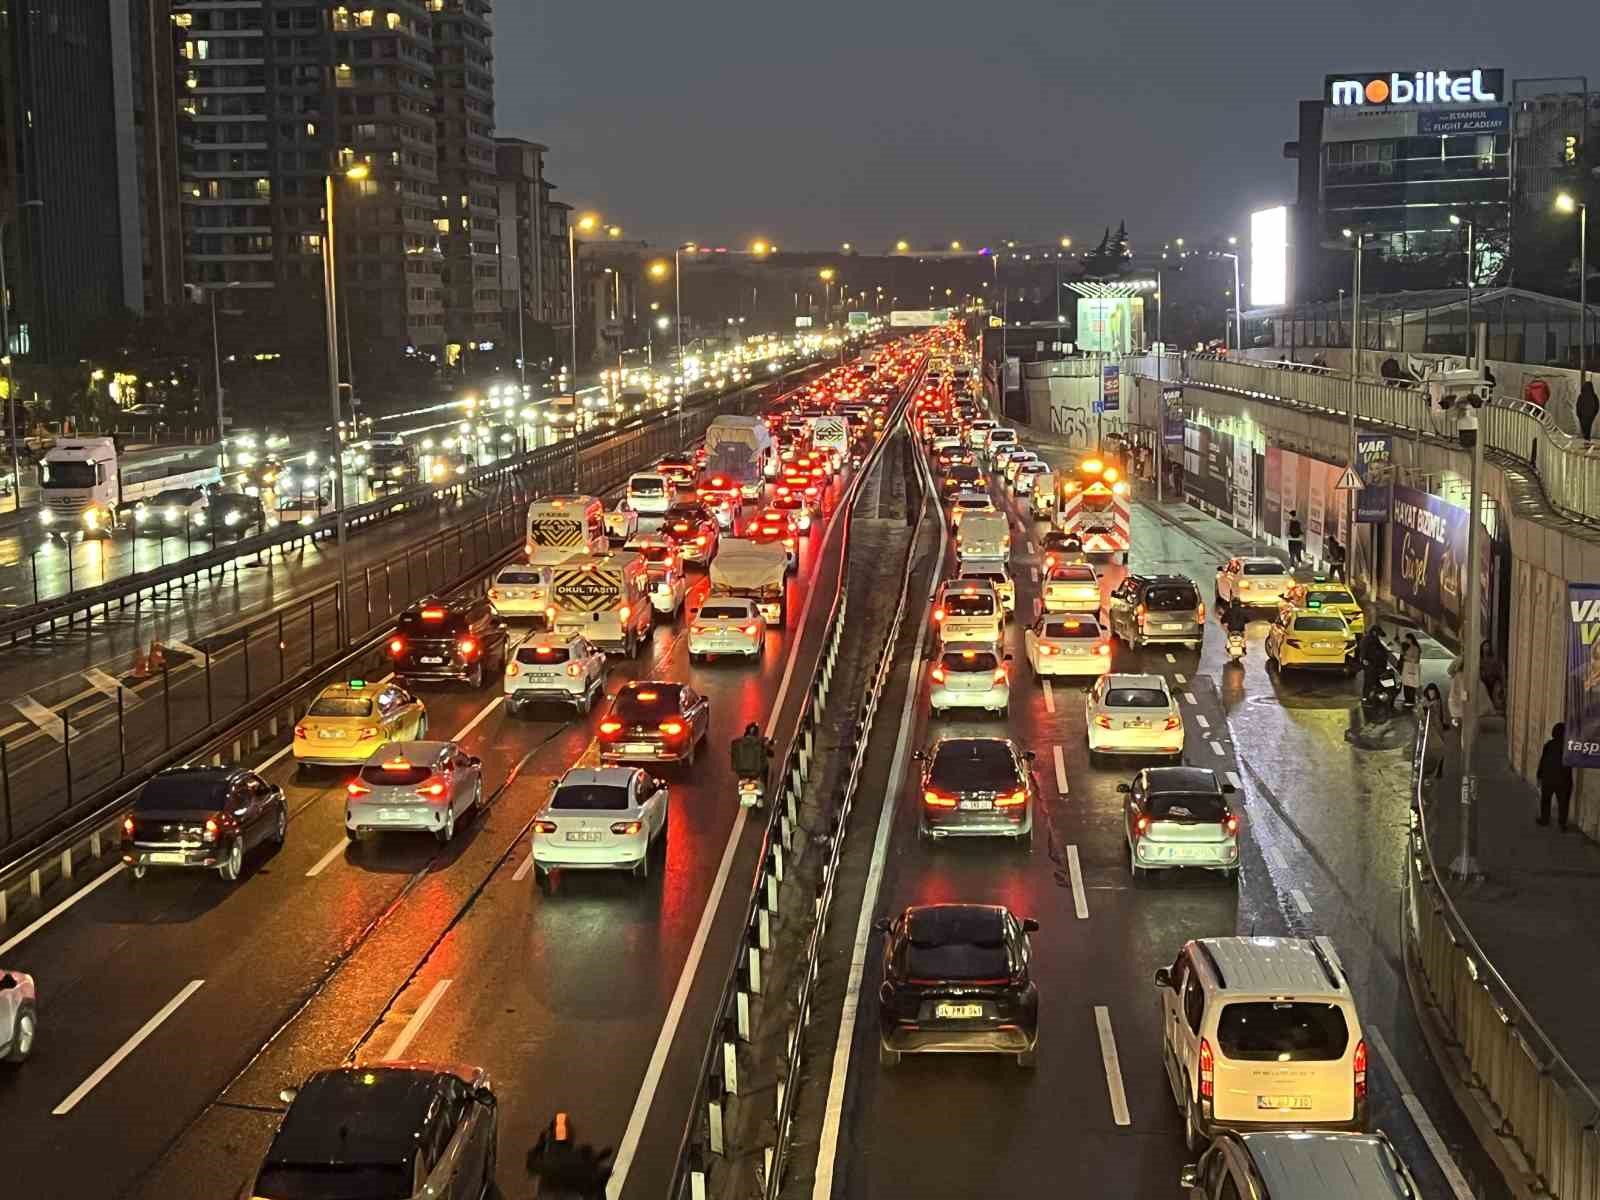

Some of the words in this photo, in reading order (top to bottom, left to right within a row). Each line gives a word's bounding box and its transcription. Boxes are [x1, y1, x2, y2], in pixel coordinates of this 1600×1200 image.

[1463, 120, 1503, 129] ACADEMY
[1359, 440, 1385, 454] VAR
[1394, 499, 1417, 529] HAYAT
[558, 586, 585, 594] OKUL
